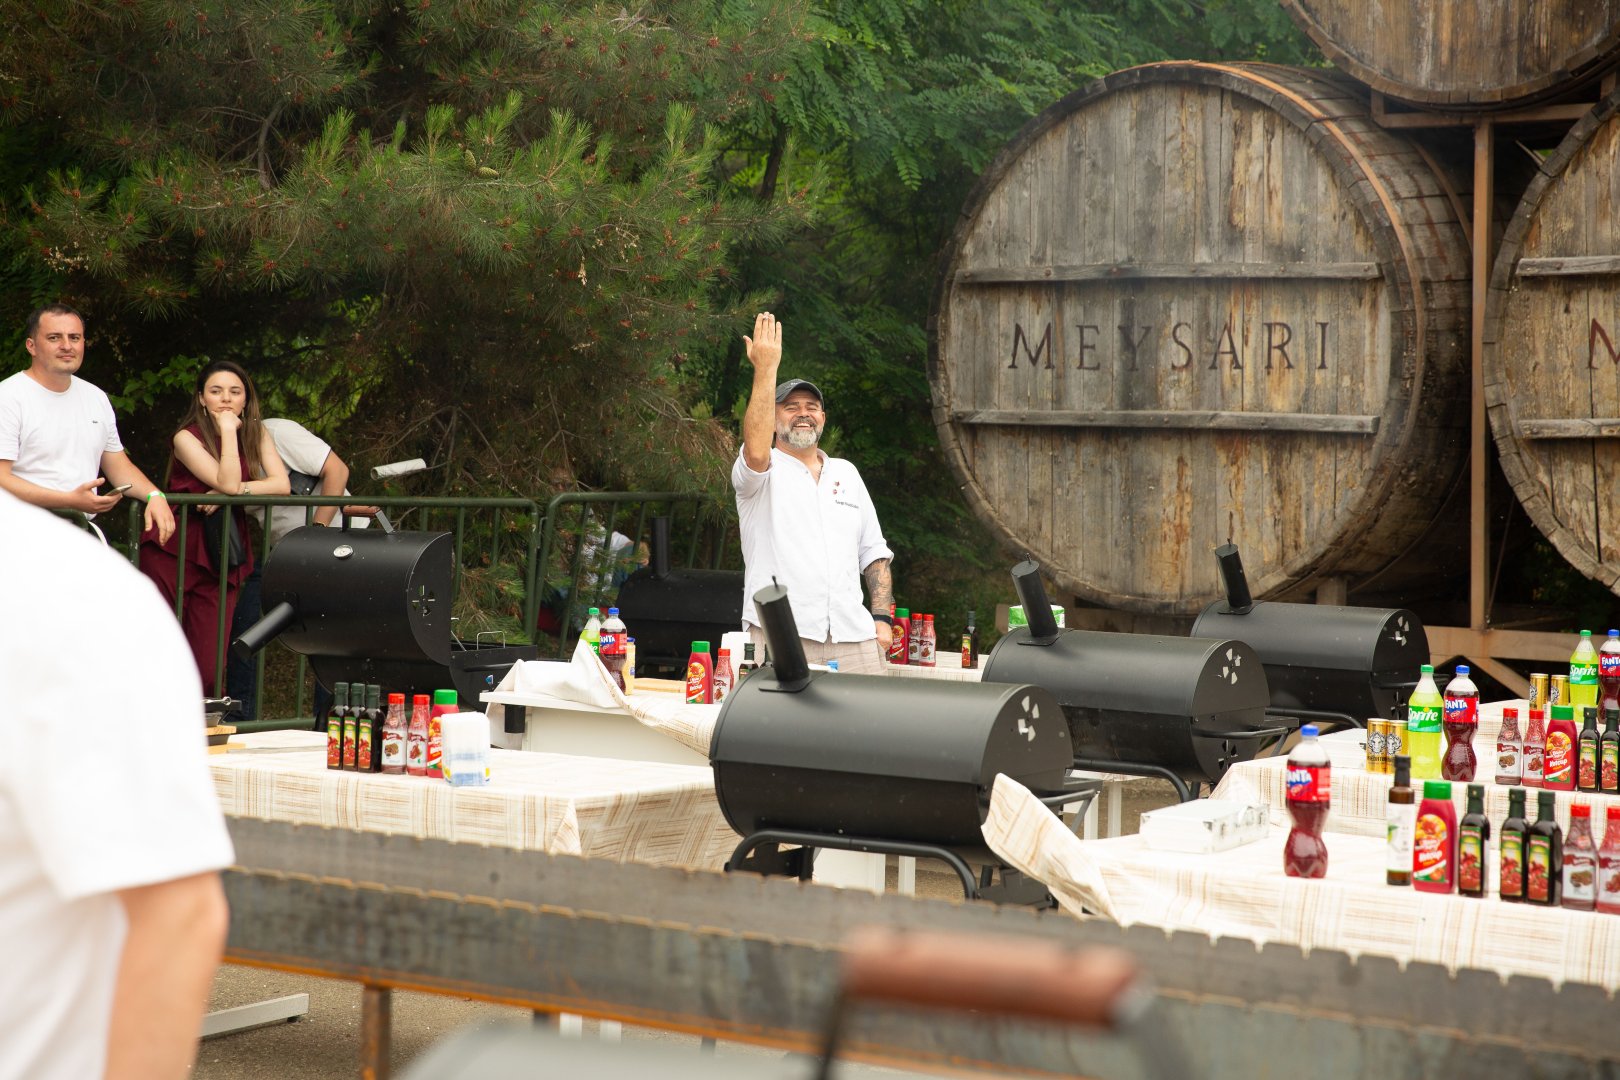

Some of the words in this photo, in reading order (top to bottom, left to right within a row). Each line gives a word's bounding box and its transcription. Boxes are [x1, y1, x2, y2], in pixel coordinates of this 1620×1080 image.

[1008, 321, 1330, 371] MEYSARI
[600, 635, 616, 643] ANTA
[1601, 657, 1620, 665] FANT
[1570, 664, 1597, 676] Sprite
[1445, 699, 1468, 709] FANTA
[1409, 707, 1439, 723] Sprite
[1286, 769, 1313, 783] ANTA
